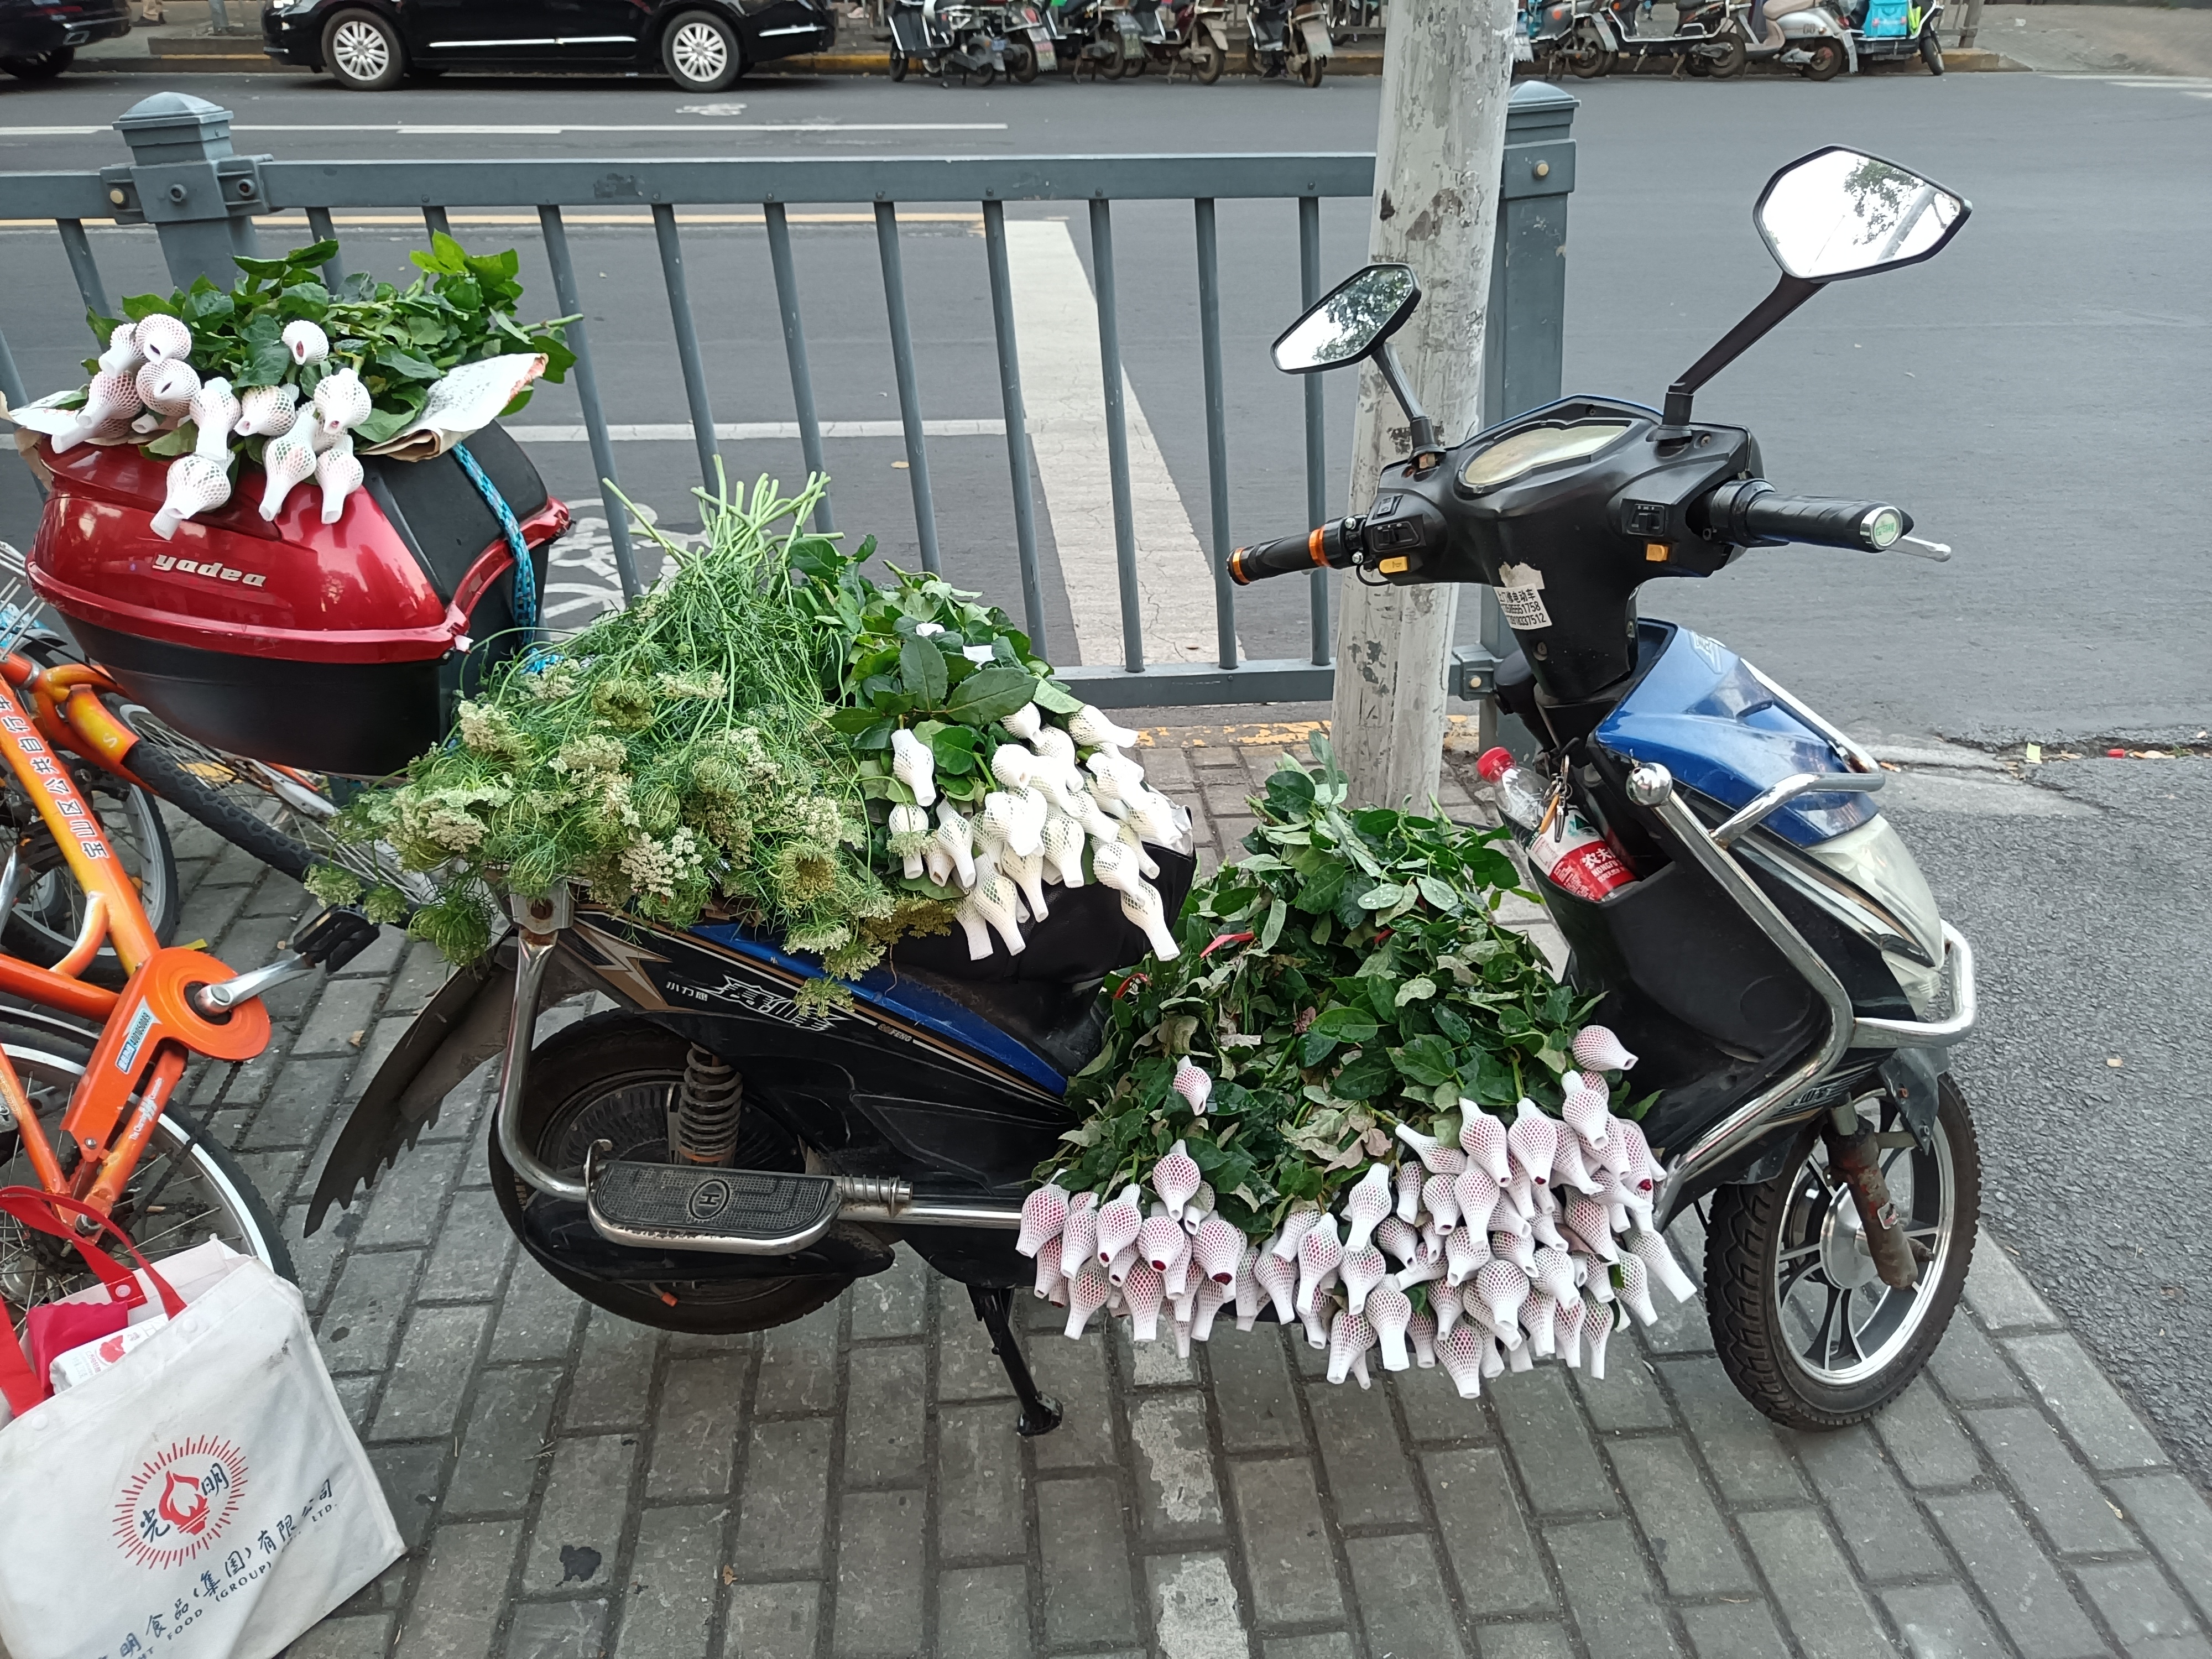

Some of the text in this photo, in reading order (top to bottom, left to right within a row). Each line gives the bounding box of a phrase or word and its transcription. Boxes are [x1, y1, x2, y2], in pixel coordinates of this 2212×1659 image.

[152, 554, 267, 587] yadea
[167, 1503, 337, 1640] FOOD (GROUP) LTD.
